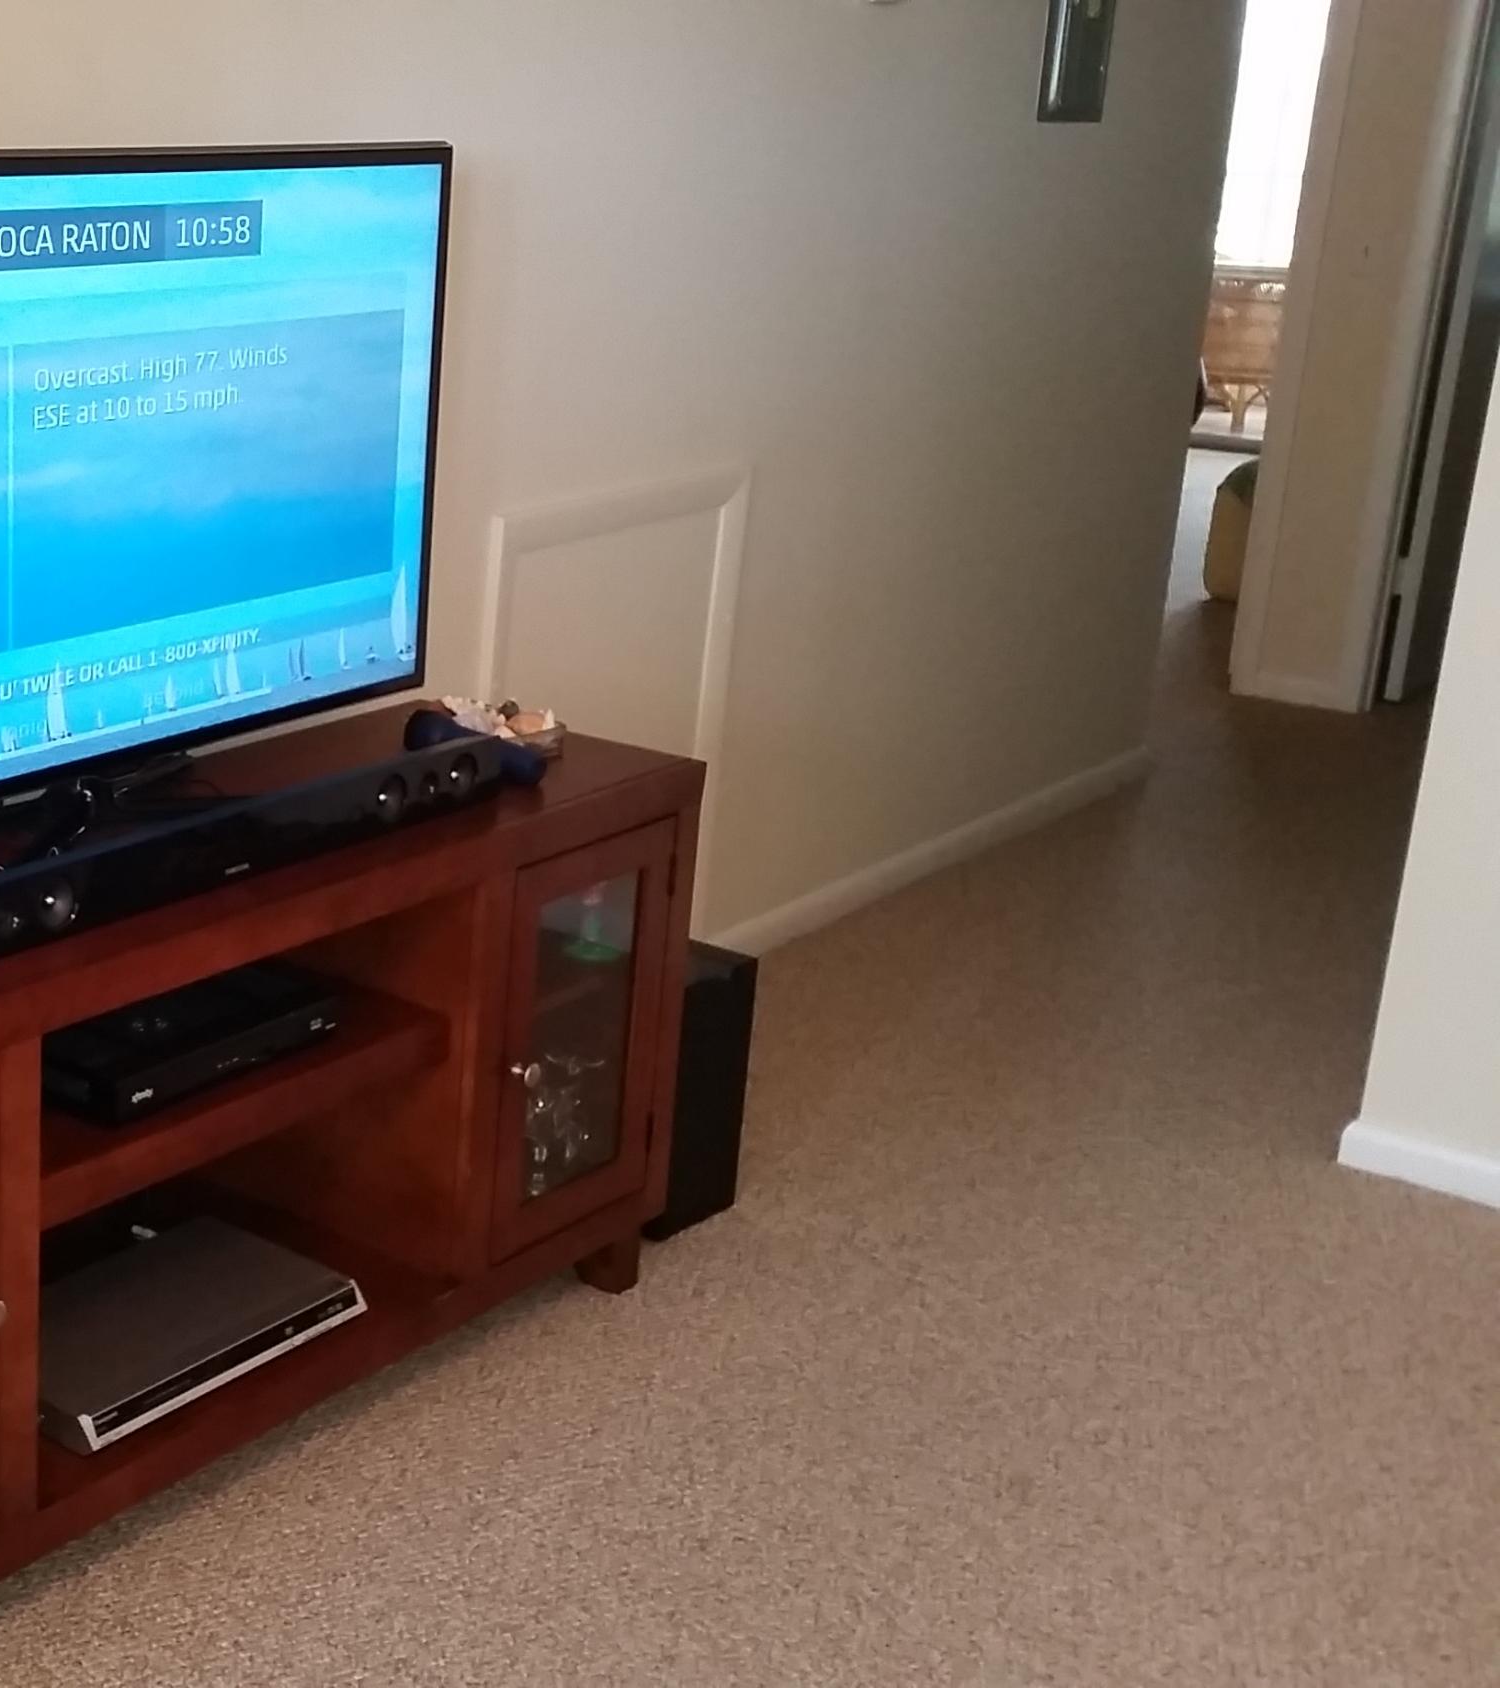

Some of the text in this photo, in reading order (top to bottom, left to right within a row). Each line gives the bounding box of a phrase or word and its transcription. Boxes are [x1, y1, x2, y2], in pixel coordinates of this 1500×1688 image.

[62, 219, 151, 254] RATON
[175, 215, 251, 248] 10:58
[34, 361, 134, 392] Overcast.
[140, 354, 188, 384] High
[228, 344, 288, 370] Winds
[33, 403, 71, 431] ESE
[76, 400, 98, 424] at
[104, 396, 130, 421] 10
[136, 395, 157, 417] to
[163, 390, 188, 415] 15
[80, 661, 104, 682] OR
[108, 651, 144, 677] CALL
